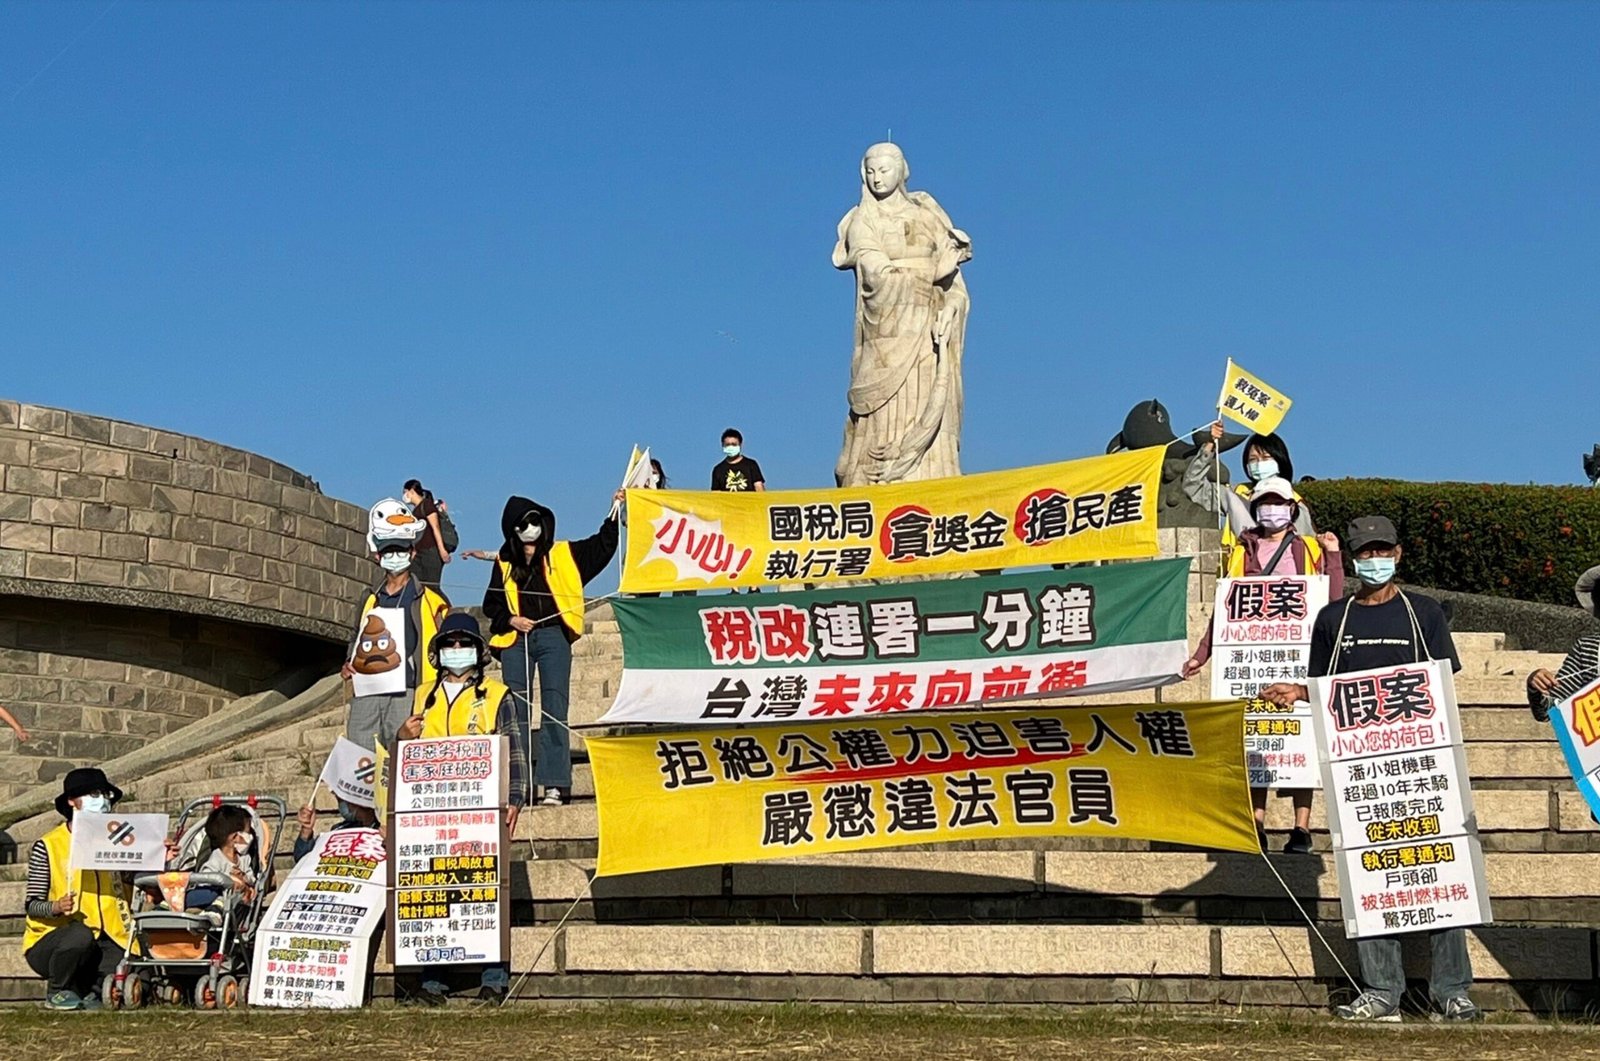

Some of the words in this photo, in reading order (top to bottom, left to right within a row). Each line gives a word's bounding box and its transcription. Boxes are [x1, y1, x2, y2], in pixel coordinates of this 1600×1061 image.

[1235, 378, 1271, 407] 救冤案
[1224, 395, 1260, 421] 護人權
[770, 502, 873, 542] 國稅局
[888, 510, 1007, 561] 貪獎金
[1025, 485, 1143, 544] 搶民產
[765, 548, 872, 581] 執行署
[1228, 581, 1305, 620] 假案
[702, 584, 1096, 664] 稅改連署一分鐘
[1230, 649, 1301, 663] 潘小姐機車
[1224, 666, 1308, 680] 超過10年未騎
[699, 661, 1088, 720] 台灣未來向前衝
[1332, 671, 1433, 728] 假案
[1332, 721, 1446, 758] 小心您的荷包！
[404, 761, 488, 779] 害家庭破碎
[1348, 755, 1437, 782] 潘小姐機車
[411, 781, 483, 795] 優秀創業青年
[1344, 774, 1449, 804] 超過10年未騎
[411, 795, 483, 809] 公司賠錢倒閉
[761, 767, 1119, 847] 嚴懲違法官員
[1356, 796, 1444, 823] 已報廢完成
[399, 813, 495, 827] 忘記到國稅局辦理
[1366, 816, 1440, 843] 從未收到
[95, 851, 143, 859] 法稅改革聯盟
[321, 832, 387, 861] 冤案
[399, 843, 447, 857] 結果被罰
[1362, 843, 1454, 871] 執行署通知
[1385, 868, 1437, 889] 戶頭卻
[399, 918, 496, 933] 留國外，稚子因此
[399, 935, 457, 948] 沒有爸爸。
